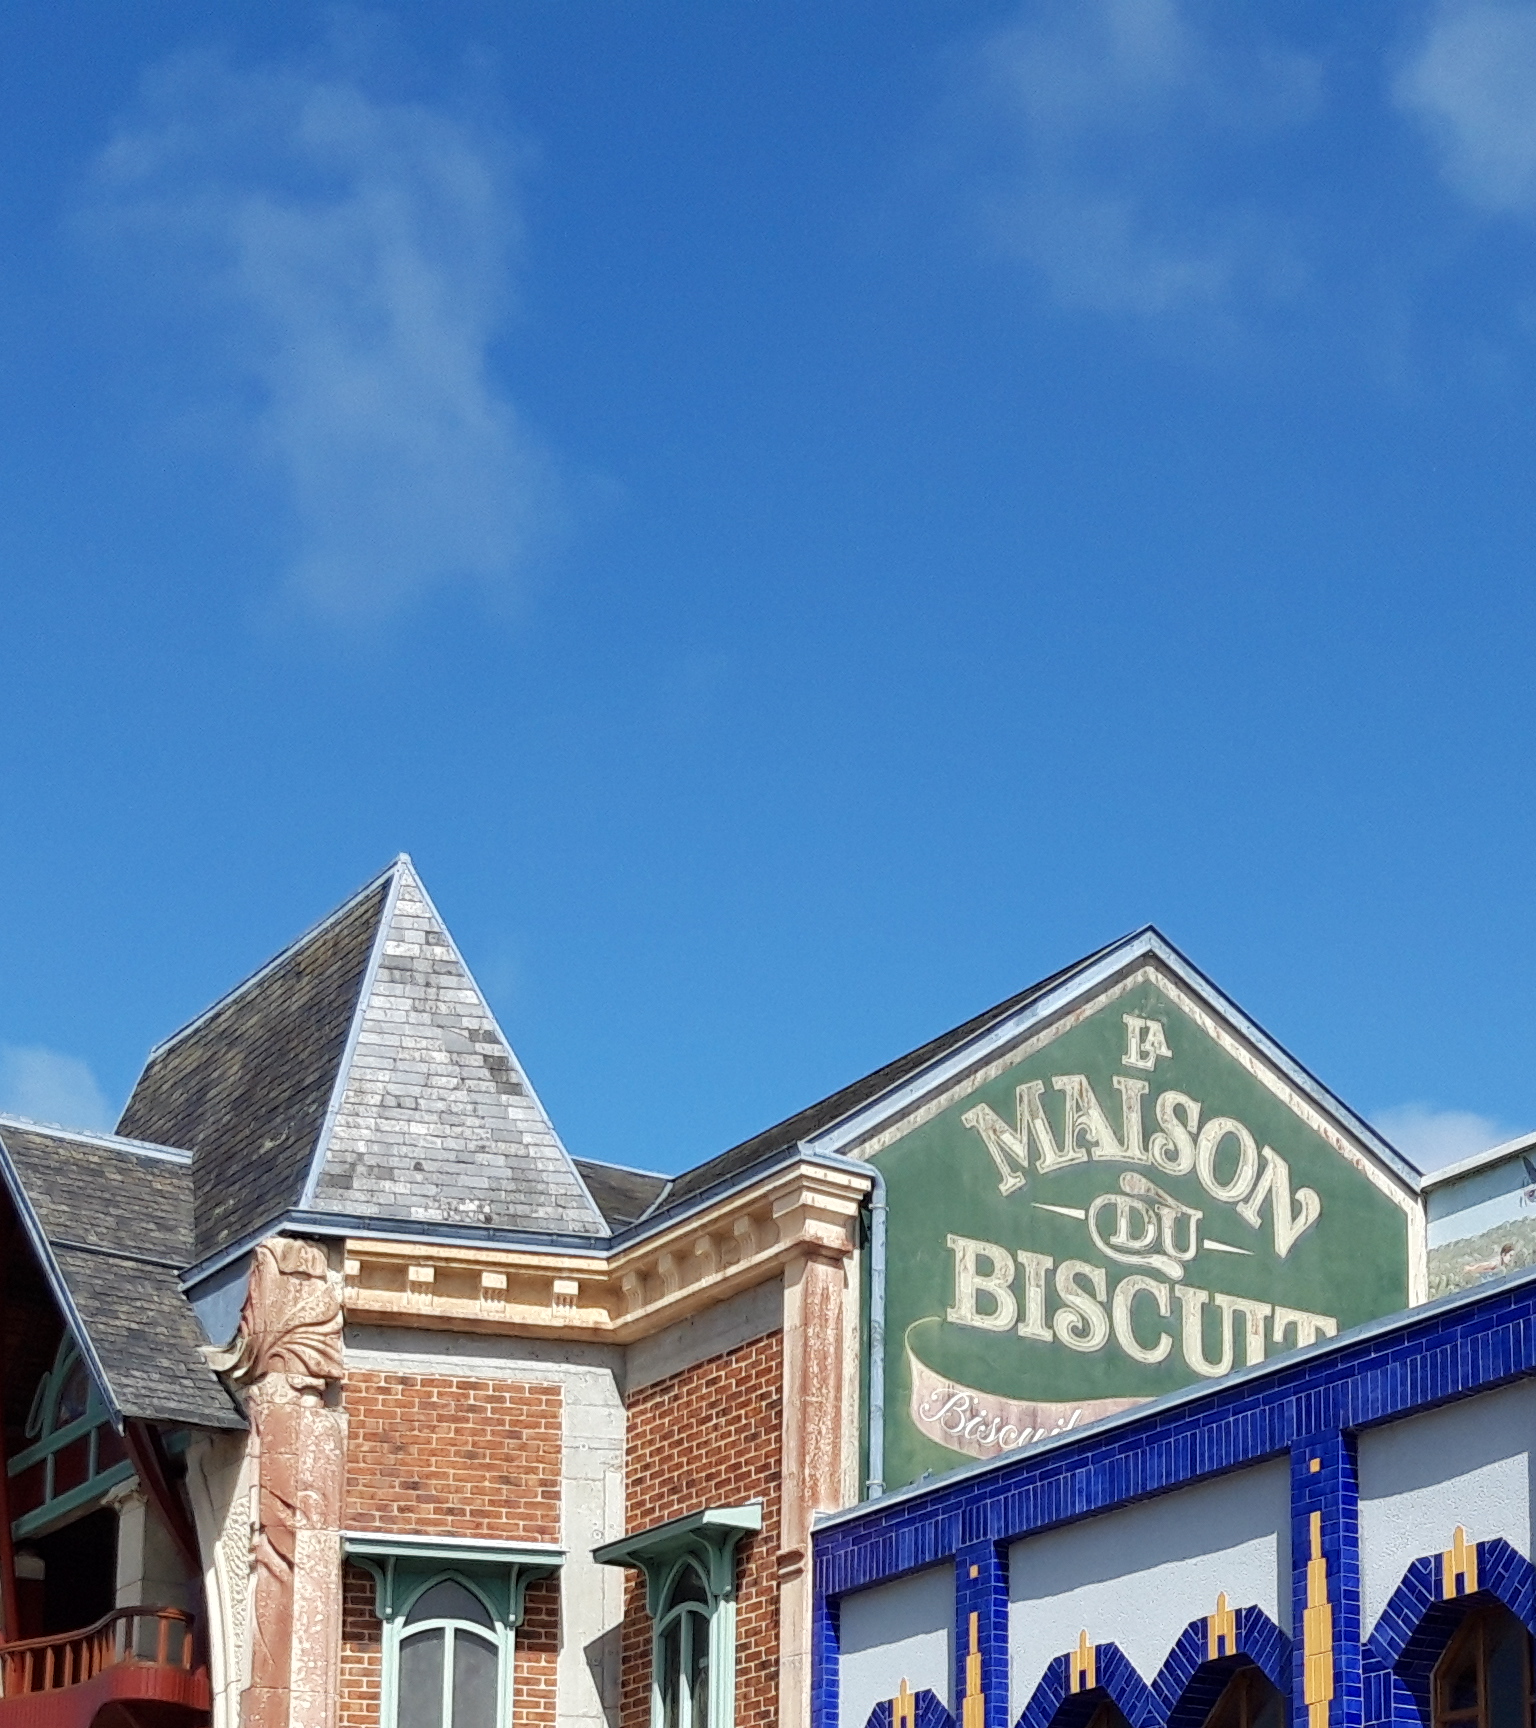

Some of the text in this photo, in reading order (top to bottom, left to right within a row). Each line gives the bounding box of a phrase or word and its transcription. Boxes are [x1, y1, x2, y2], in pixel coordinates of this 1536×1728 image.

[1122, 1013, 1173, 1071] LA
[961, 1073, 1321, 1258] MAISON
[1088, 1171, 1203, 1281] DU
